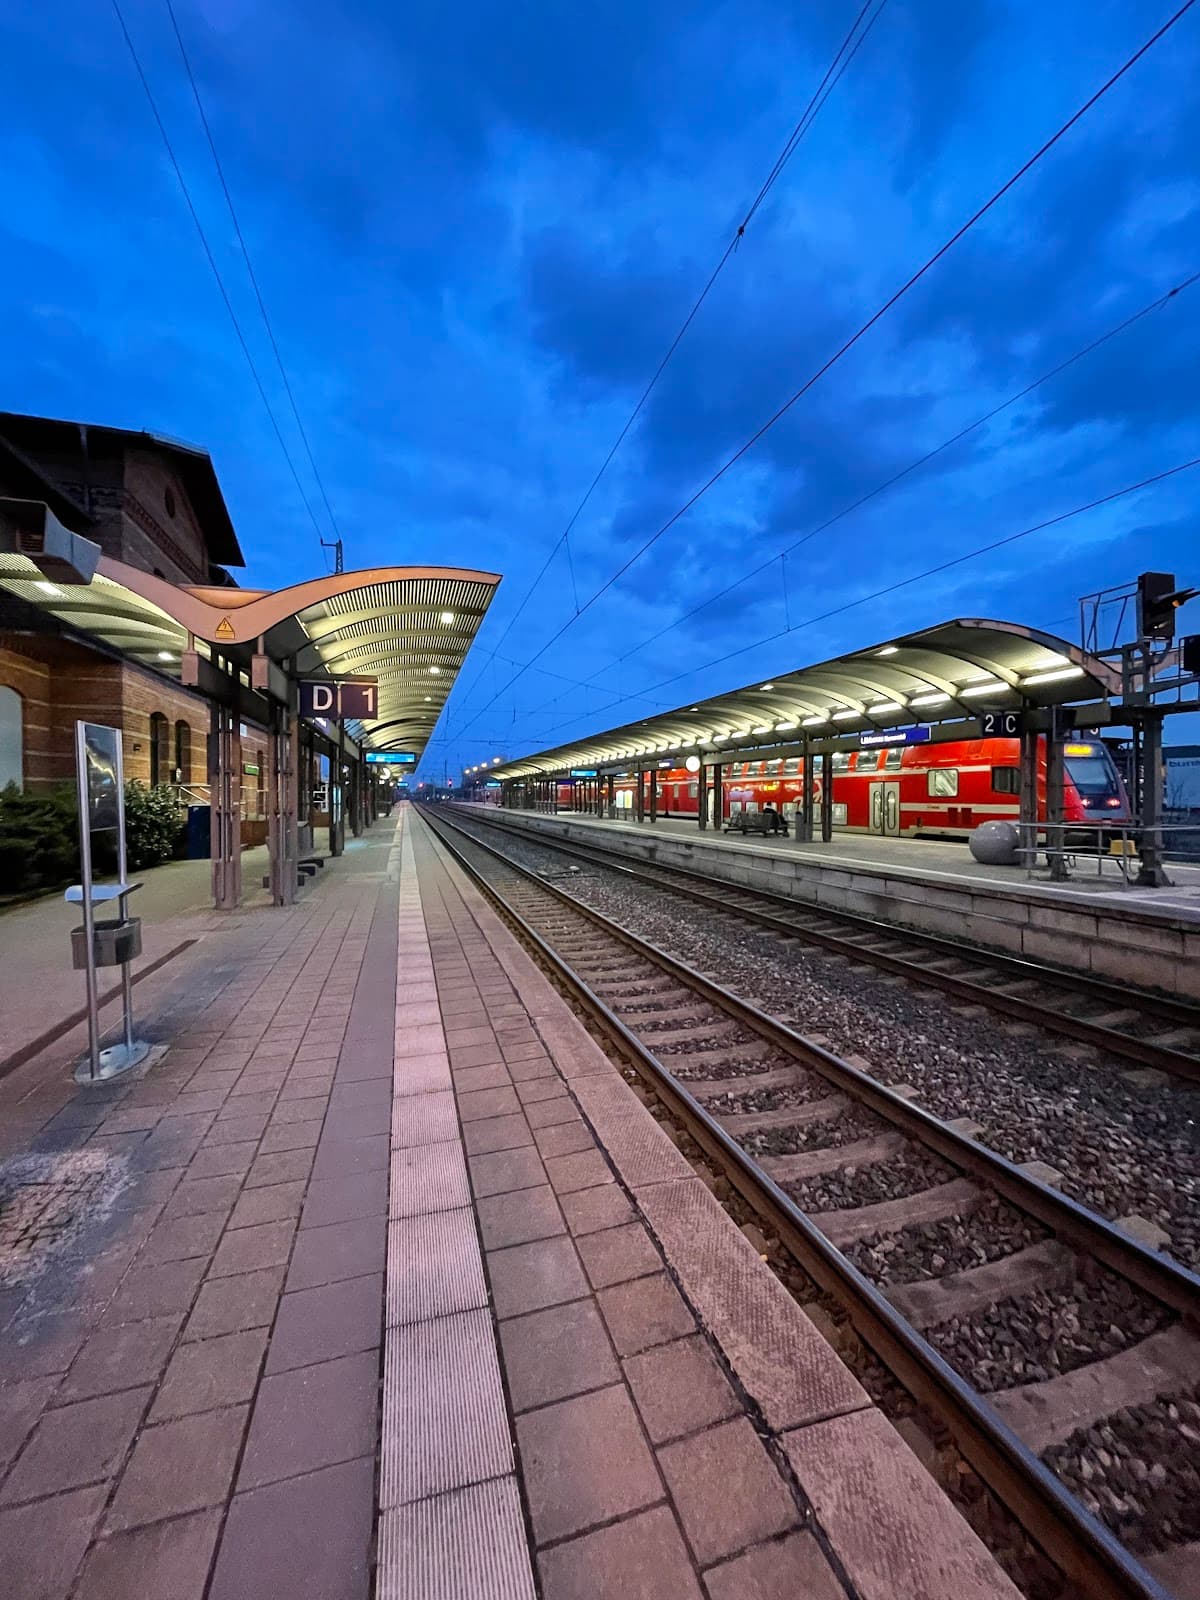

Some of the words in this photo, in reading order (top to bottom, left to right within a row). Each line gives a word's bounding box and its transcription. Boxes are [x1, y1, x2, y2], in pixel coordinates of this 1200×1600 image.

[313, 685, 333, 710] D
[362, 687, 374, 712] 1
[985, 714, 994, 732] 2
[1005, 715, 1016, 733] C
